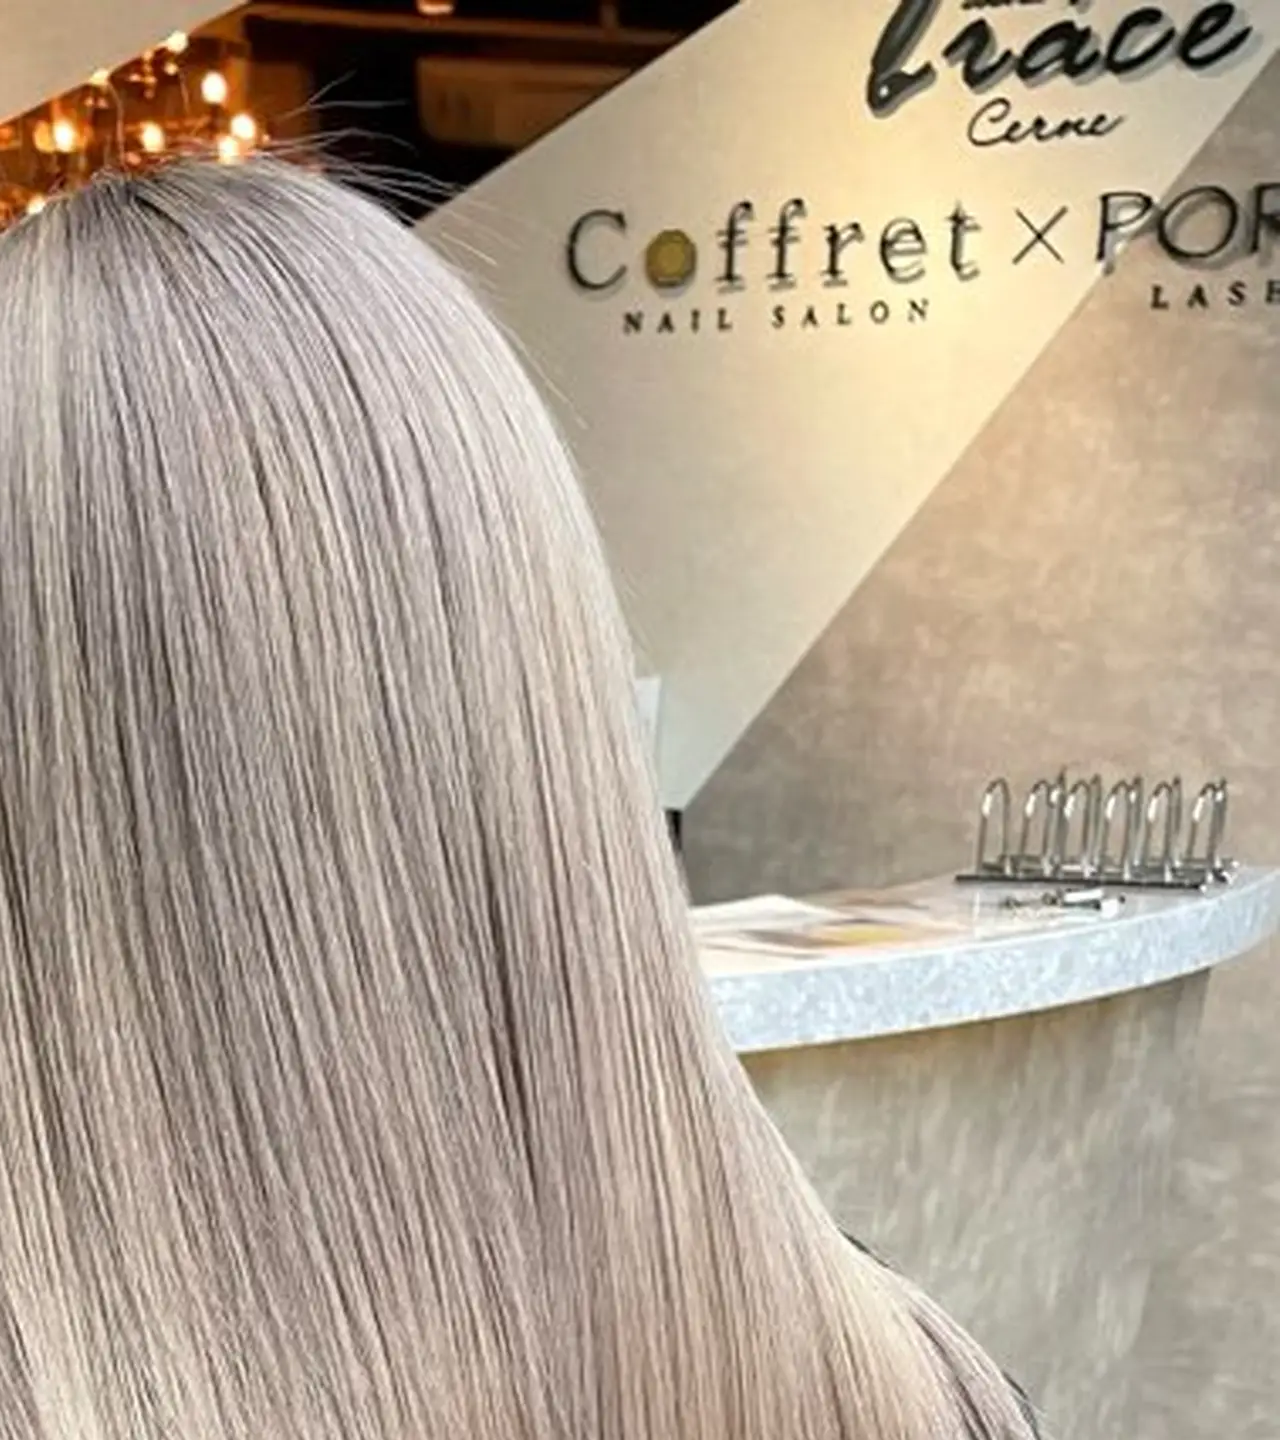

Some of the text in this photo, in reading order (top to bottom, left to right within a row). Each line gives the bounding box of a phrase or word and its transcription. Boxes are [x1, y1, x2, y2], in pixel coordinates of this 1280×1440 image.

[565, 198, 982, 292] Coffret
[623, 298, 929, 335] NAIL SALON
